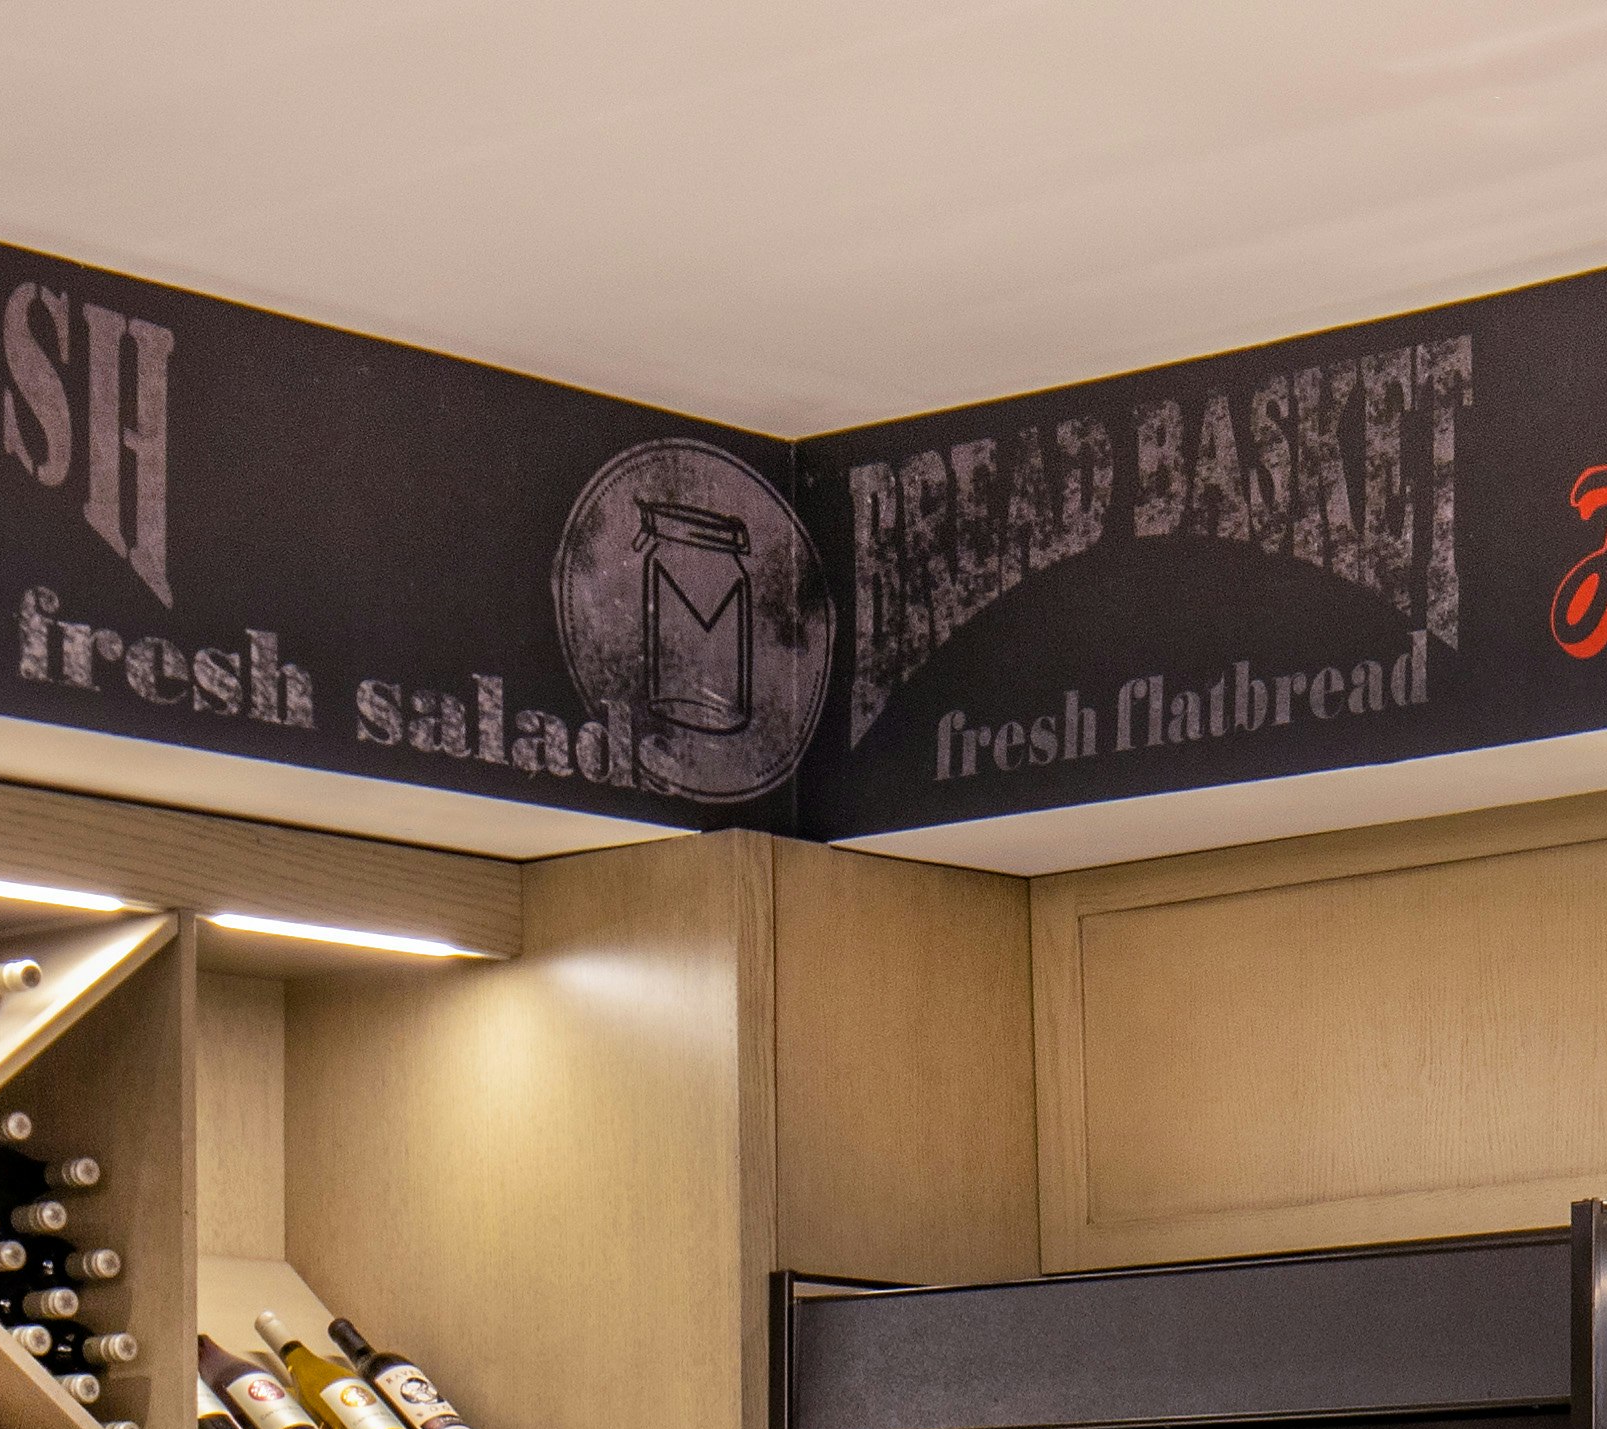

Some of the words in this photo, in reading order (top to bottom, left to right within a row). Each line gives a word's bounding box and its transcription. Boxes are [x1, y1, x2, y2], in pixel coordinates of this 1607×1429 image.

[849, 416, 1115, 751] BREAD
[1133, 334, 1474, 652] BASKET
[16, 585, 317, 730] fresh
[356, 672, 686, 797] salads
[934, 688, 1098, 782] fresh
[1114, 630, 1431, 754] flatbread
